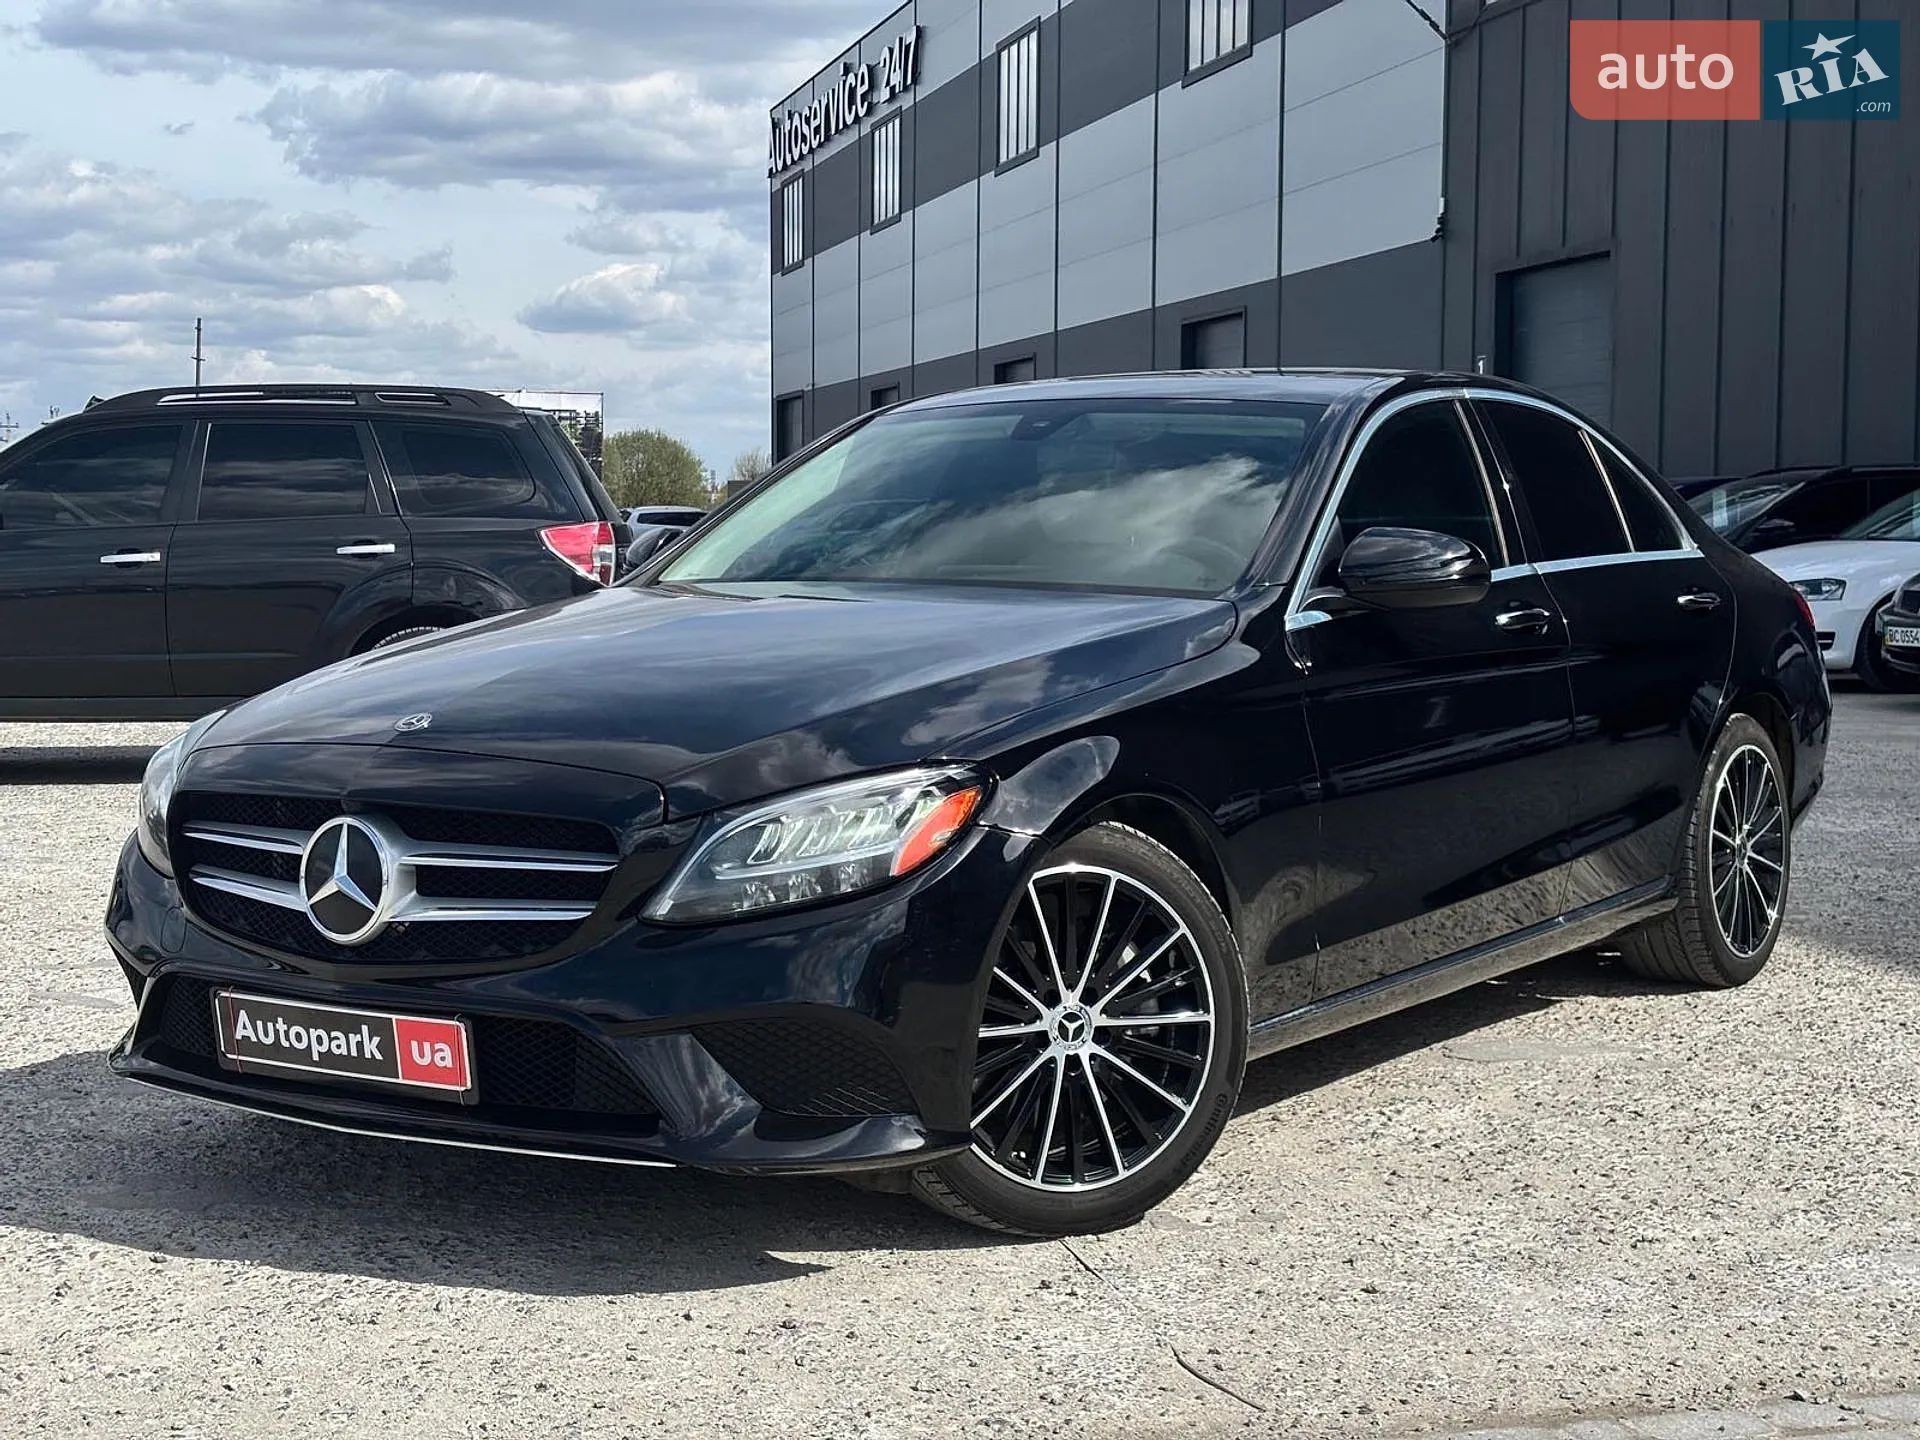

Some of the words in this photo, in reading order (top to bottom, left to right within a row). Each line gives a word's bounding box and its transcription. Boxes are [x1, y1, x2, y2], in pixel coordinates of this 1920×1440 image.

[767, 62, 870, 174] Autoservice
[879, 25, 919, 104] 24/7
[235, 1009, 384, 1061] Autopark
[410, 1038, 454, 1069] ua
